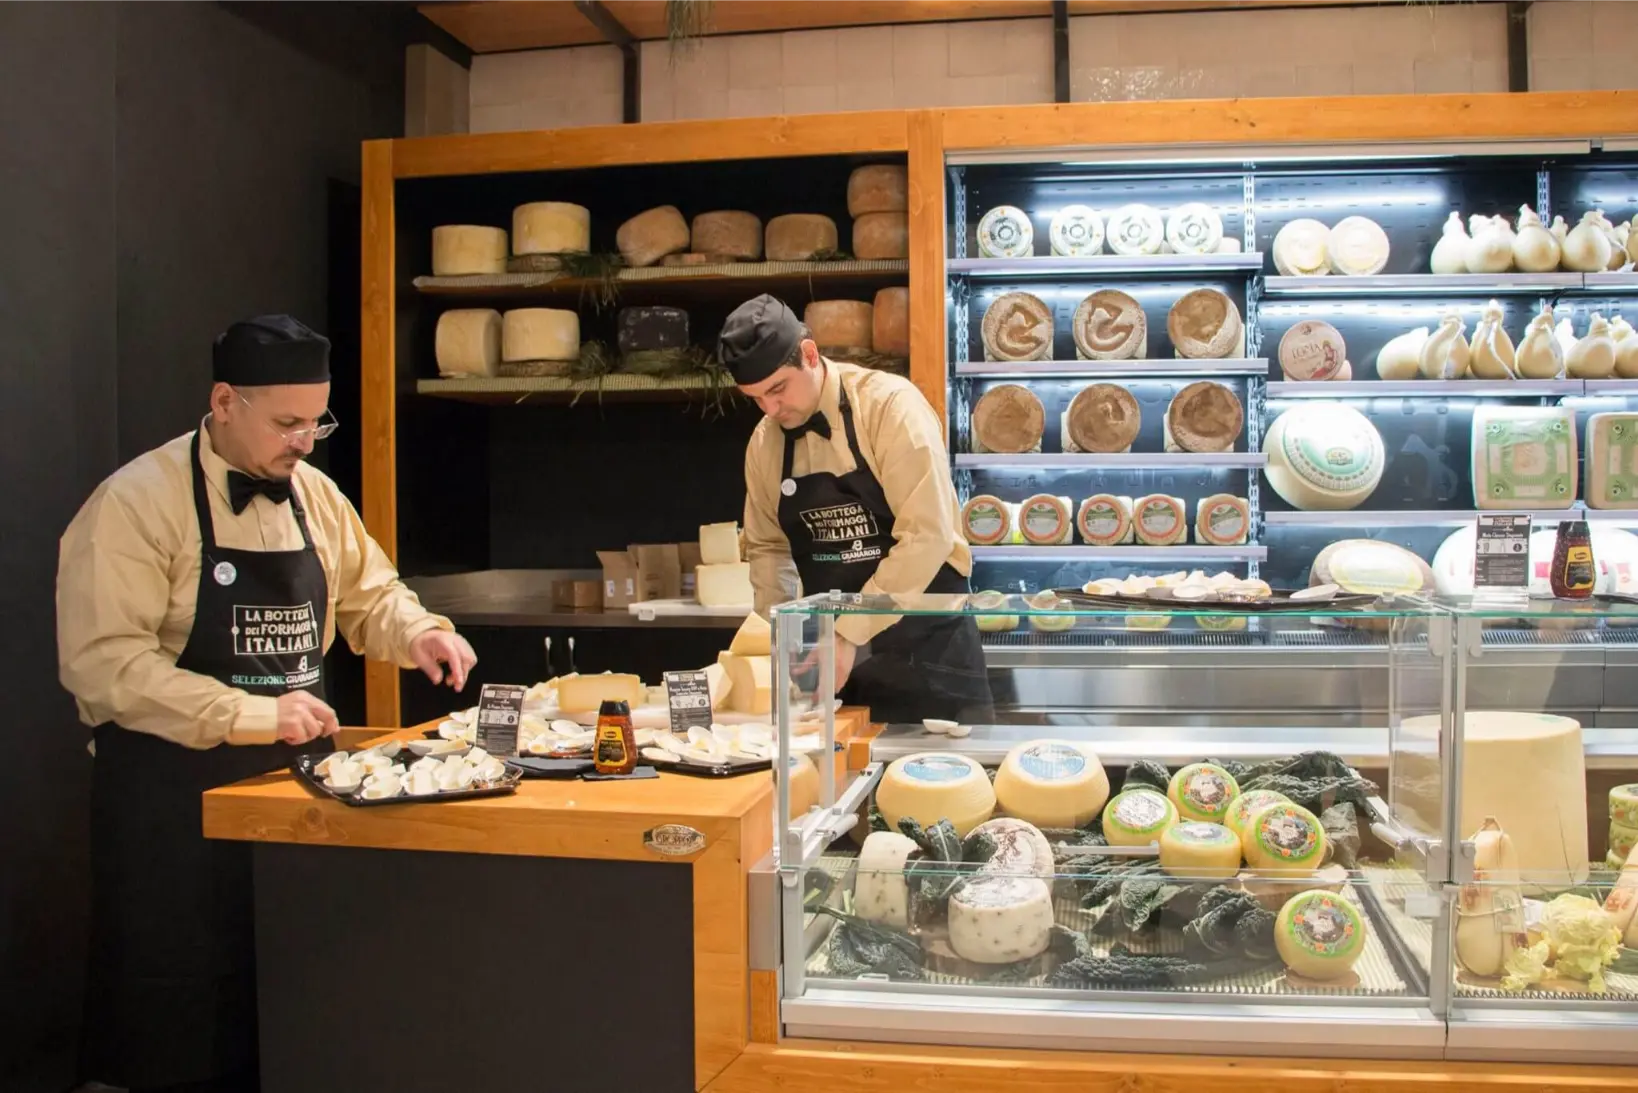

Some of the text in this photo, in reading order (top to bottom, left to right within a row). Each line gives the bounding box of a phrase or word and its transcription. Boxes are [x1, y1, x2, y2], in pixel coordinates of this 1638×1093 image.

[808, 504, 864, 520] LA BOTTEGA
[818, 524, 870, 539] ITALIANI
[245, 610, 261, 622] LA
[245, 627, 259, 635] DEI
[246, 634, 312, 652] ITALIANI
[231, 675, 285, 684] SELEZIONE
